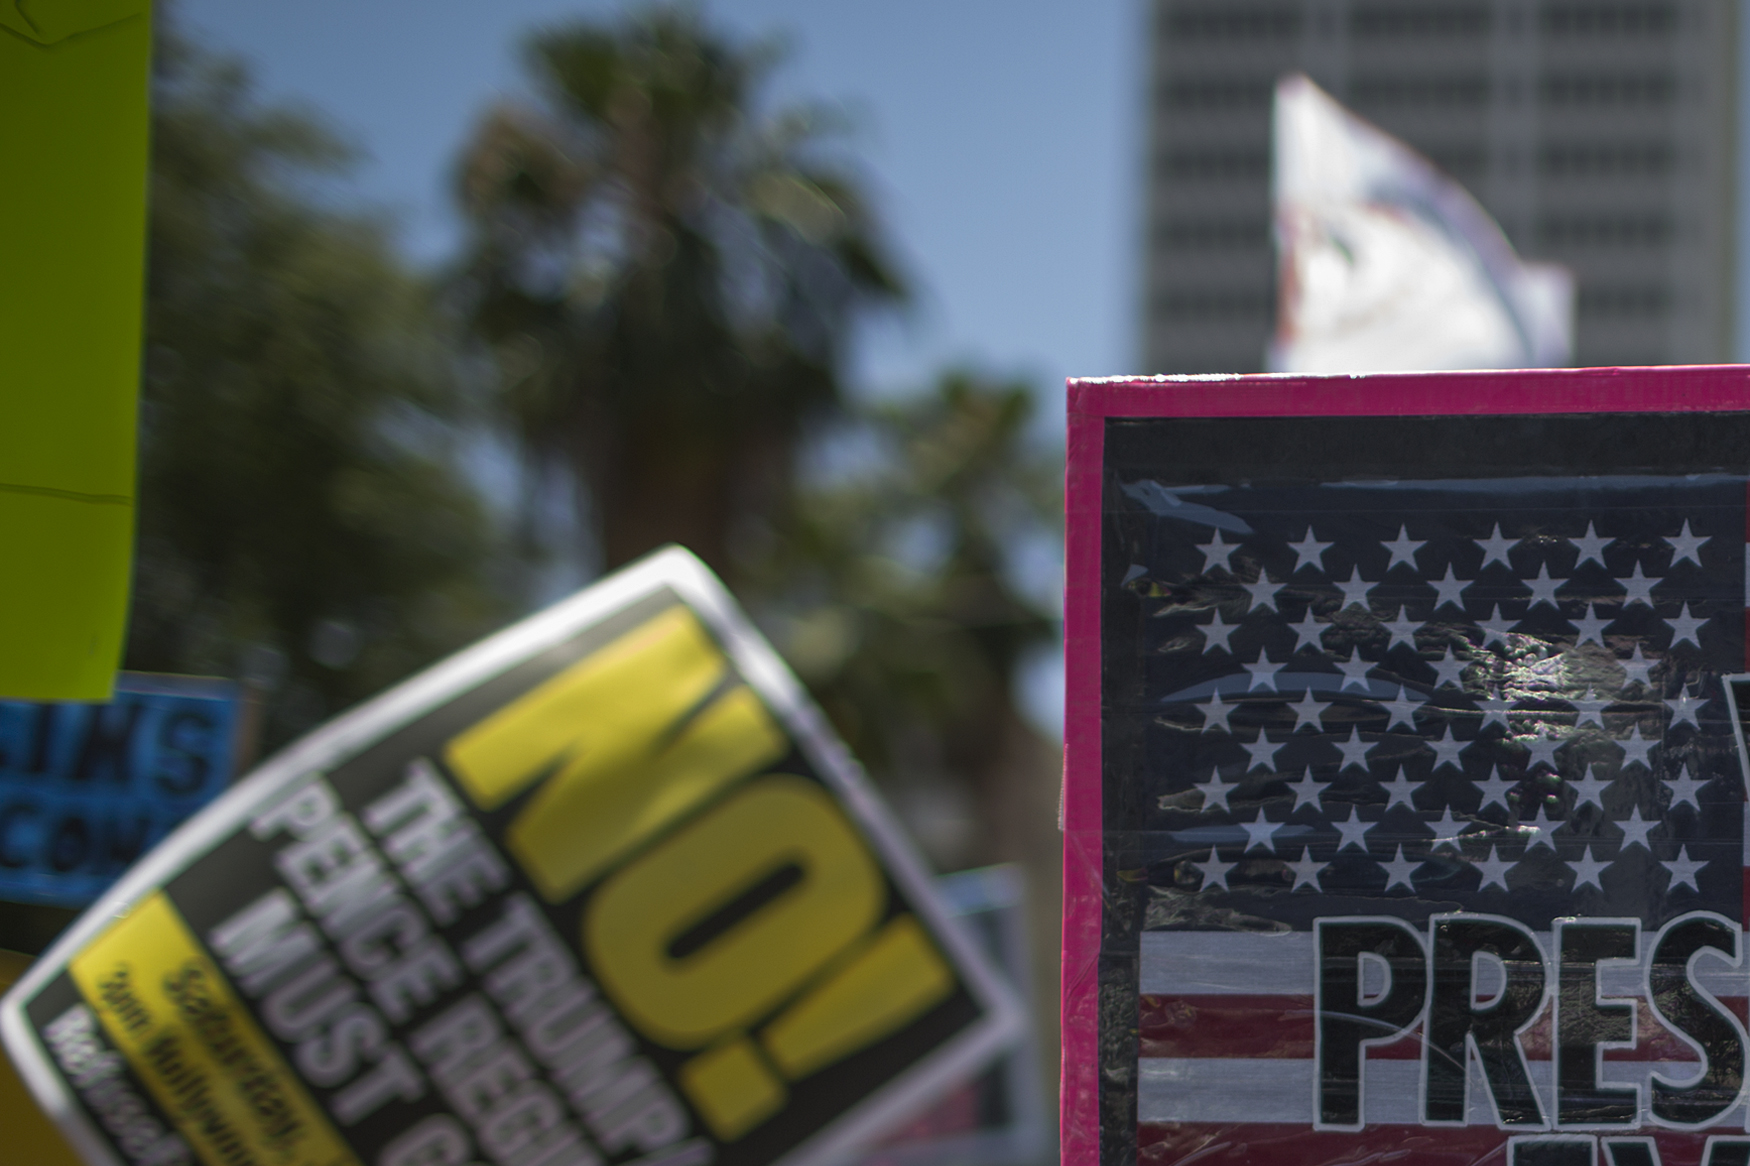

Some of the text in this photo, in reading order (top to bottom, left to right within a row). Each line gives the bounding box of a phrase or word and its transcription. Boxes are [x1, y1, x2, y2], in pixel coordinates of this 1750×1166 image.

[247, 773, 464, 1024] PENCE
[362, 755, 511, 927] THE
[443, 604, 954, 1144] NO!
[209, 886, 425, 1127] MUST
